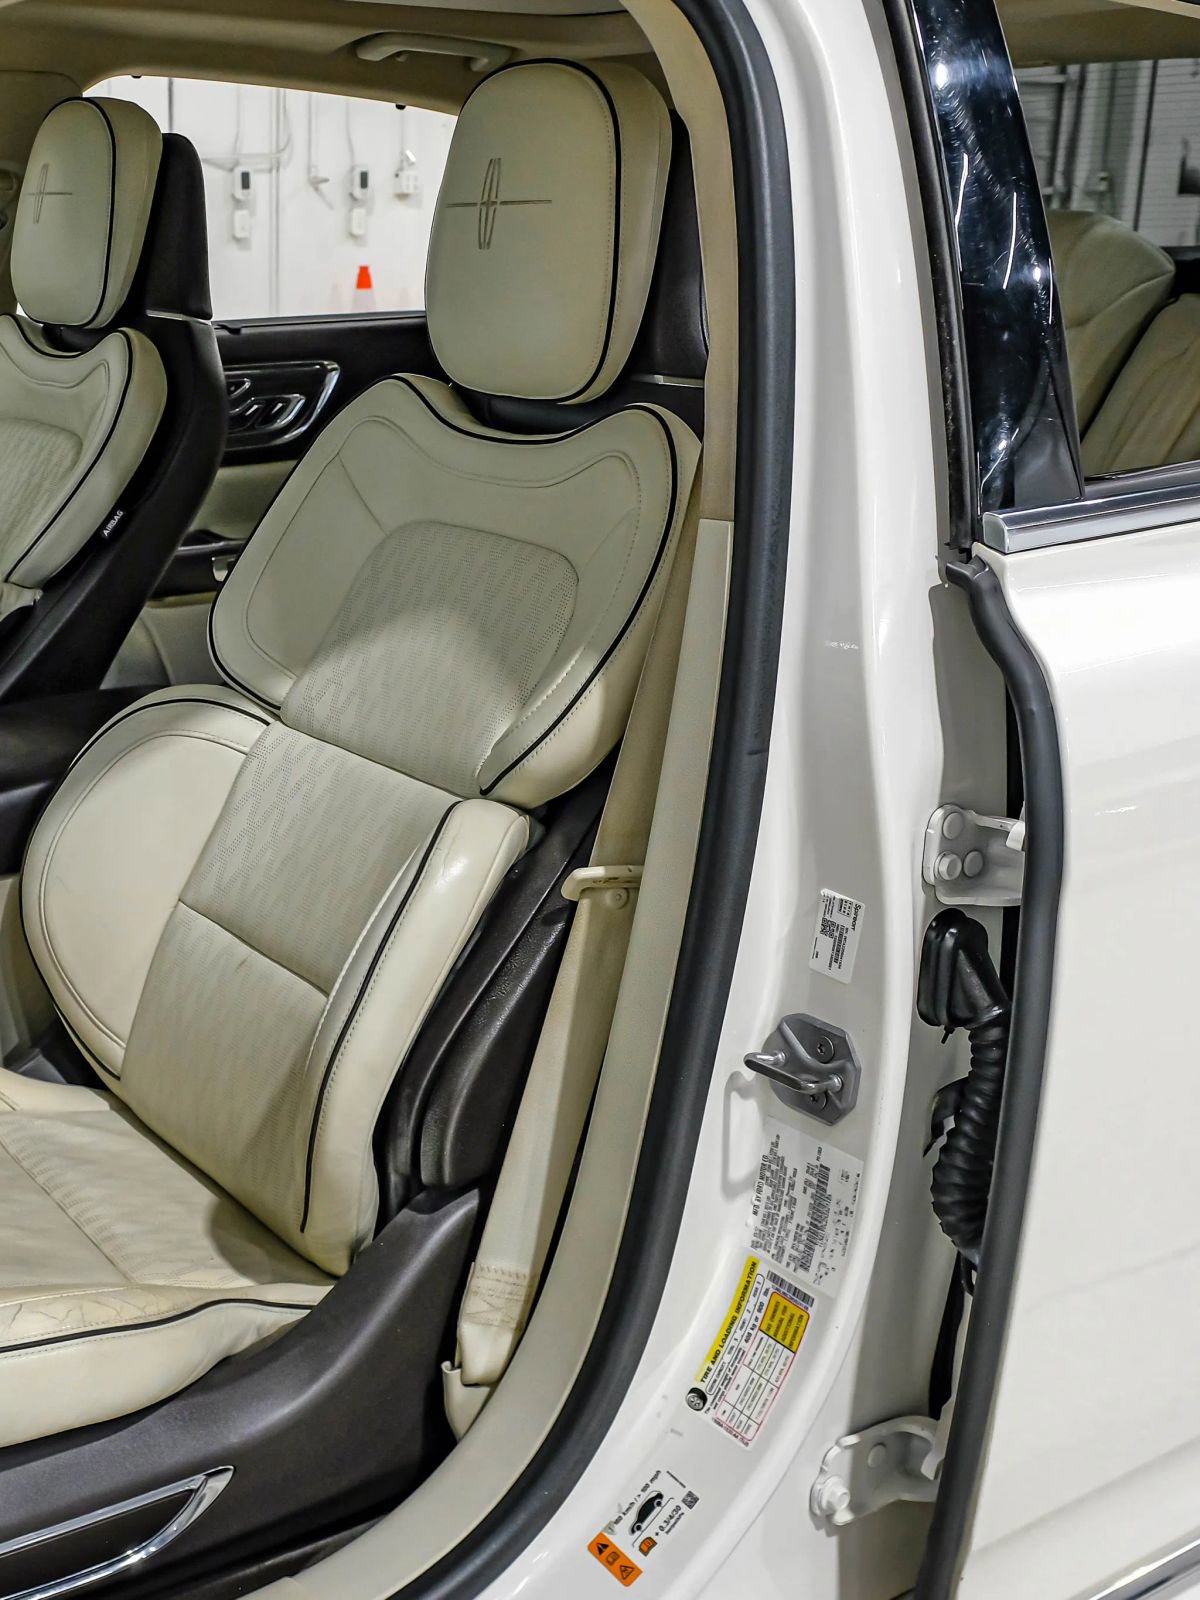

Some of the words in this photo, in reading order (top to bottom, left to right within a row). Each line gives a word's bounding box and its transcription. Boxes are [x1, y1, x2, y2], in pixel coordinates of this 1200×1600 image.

[102, 509, 125, 537] AIRBAG
[759, 1163, 767, 1180] MOTOR
[701, 1367, 712, 1383] TIRE
[711, 1350, 721, 1364] AND
[719, 1315, 737, 1348] LOADING
[735, 1262, 757, 1314] INFORMATION
[750, 1323, 757, 1331] kg
[650, 1470, 661, 1483] mph
